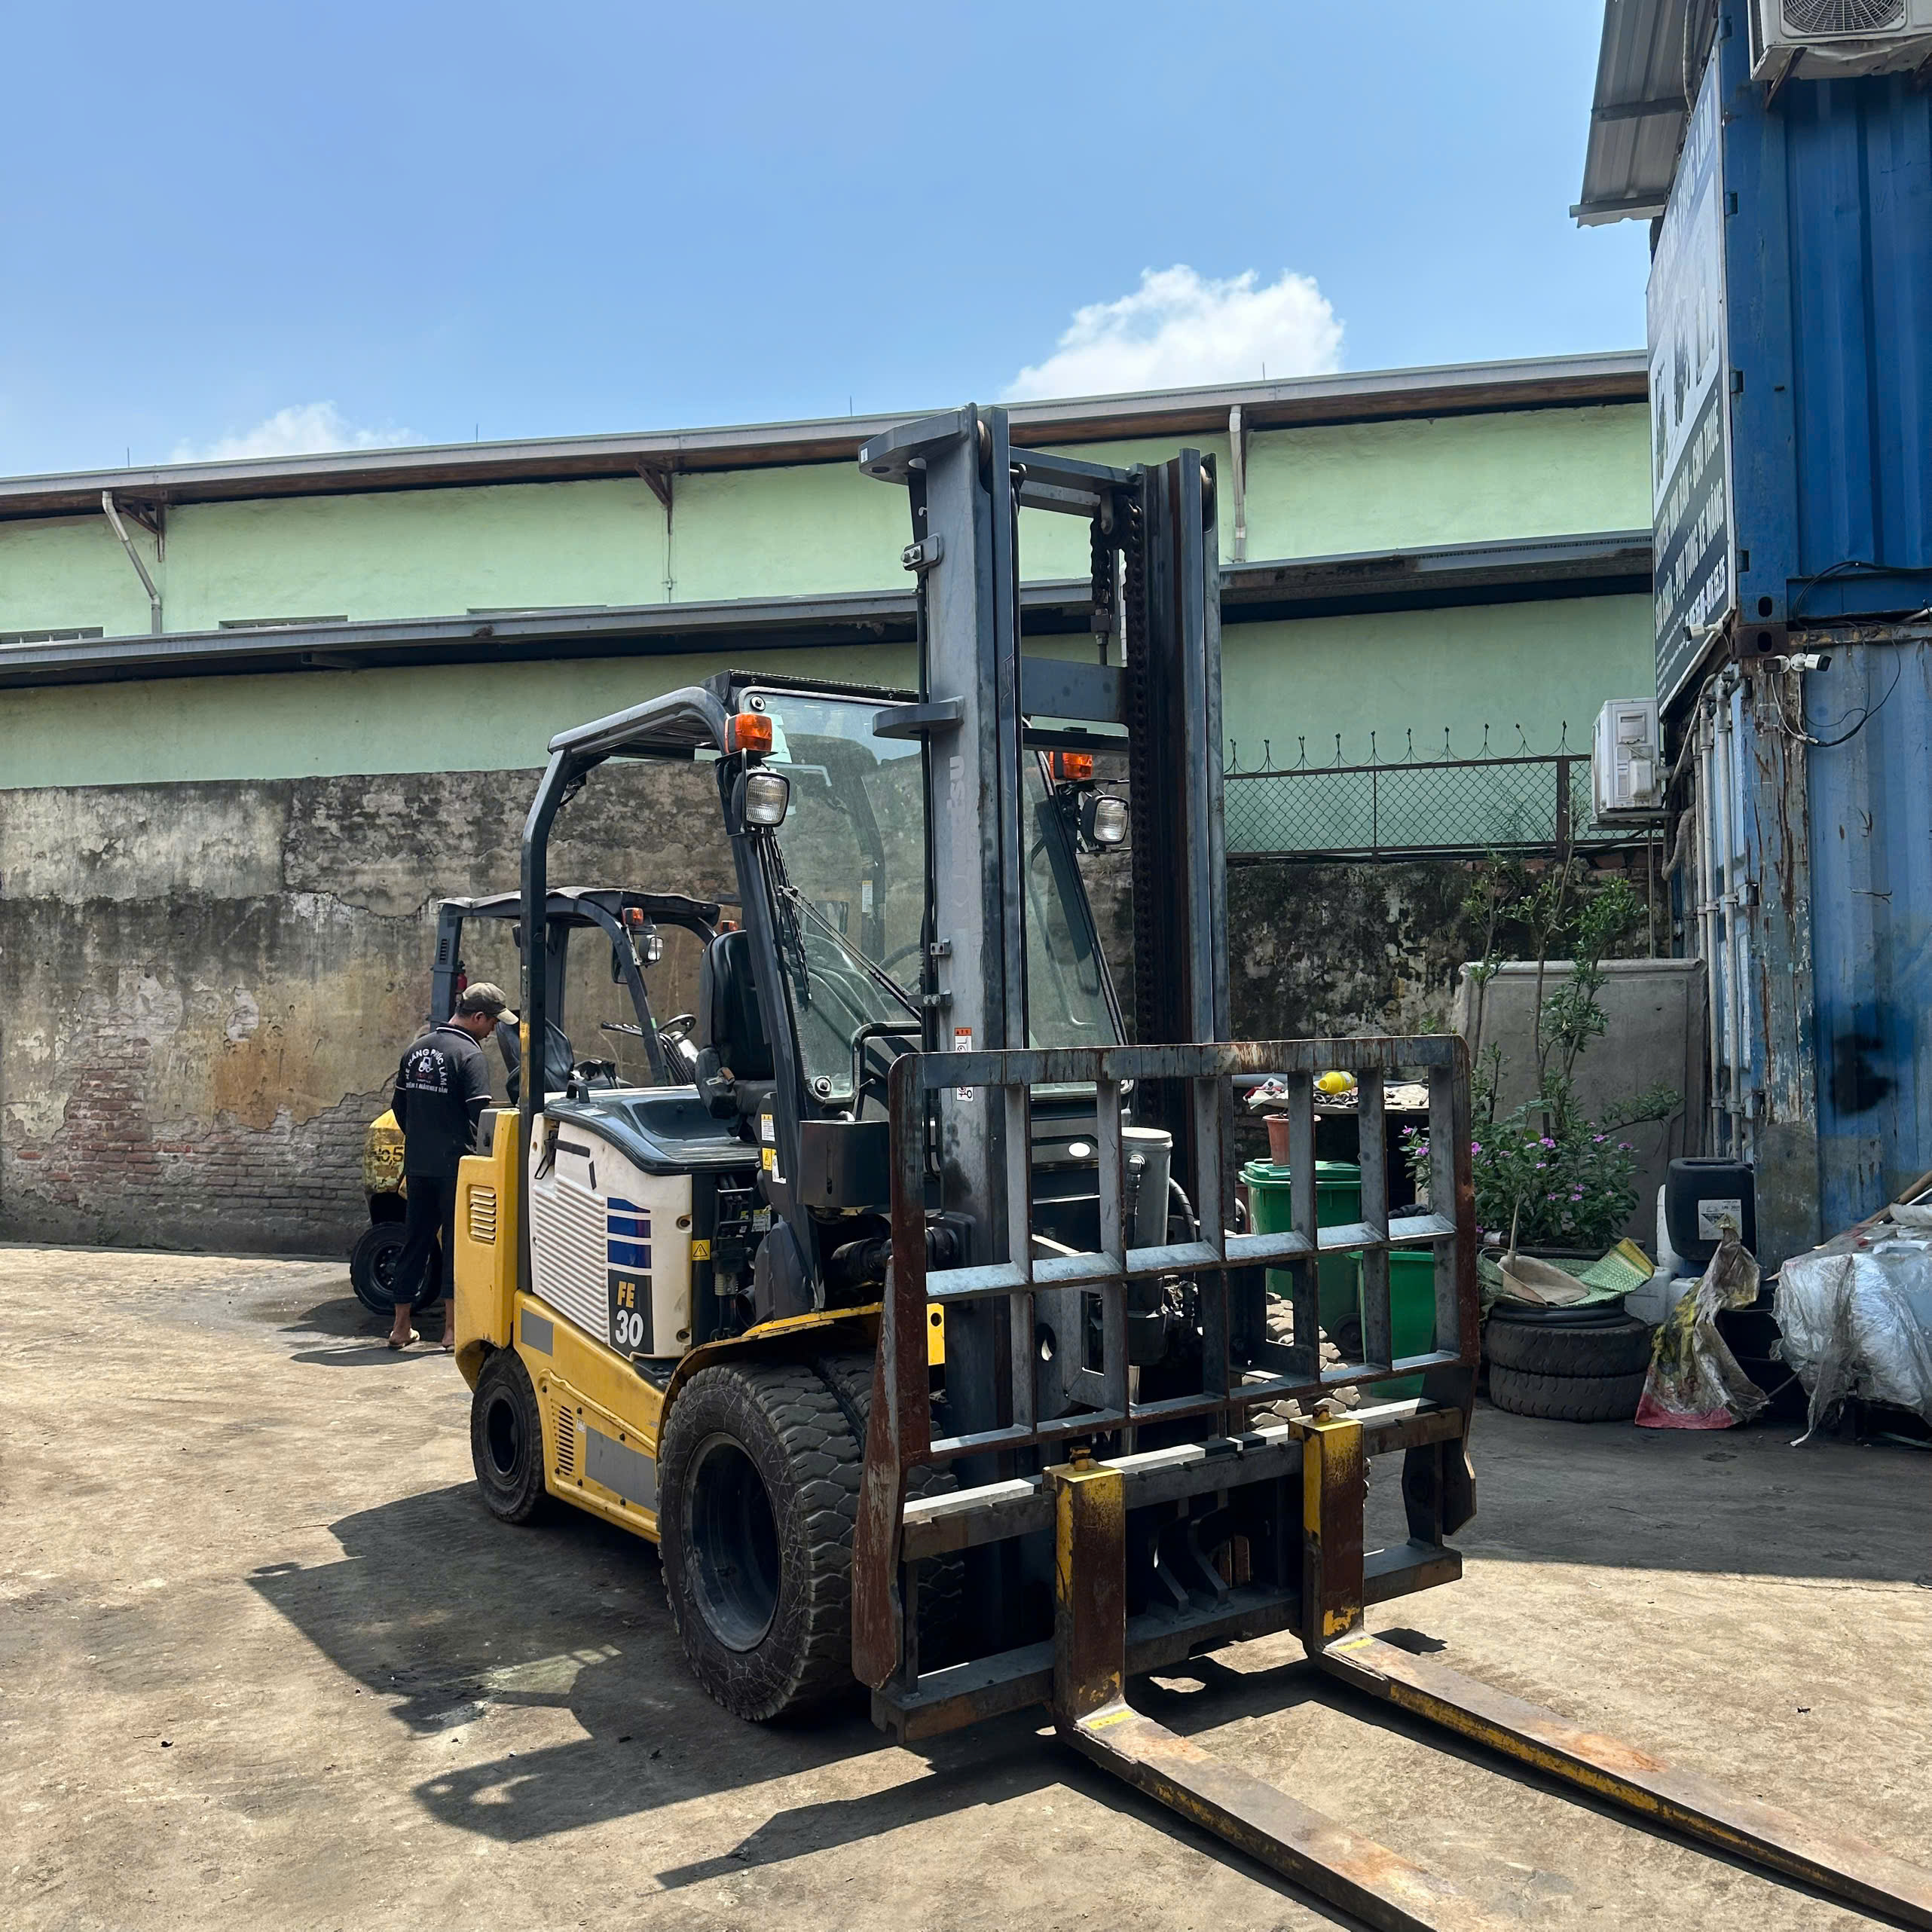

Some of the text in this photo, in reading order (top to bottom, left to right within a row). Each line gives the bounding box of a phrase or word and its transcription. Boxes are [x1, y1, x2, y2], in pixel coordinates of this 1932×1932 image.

[1678, 145, 1695, 235] PHÚC
[1696, 88, 1712, 179] LÂM
[1692, 430, 1703, 489] CHO
[1704, 388, 1719, 464] THUÊ
[1698, 508, 1706, 561] XE
[1706, 477, 1723, 546] NÂNG
[616, 1310, 644, 1347] 30
[617, 1281, 635, 1308] FE
